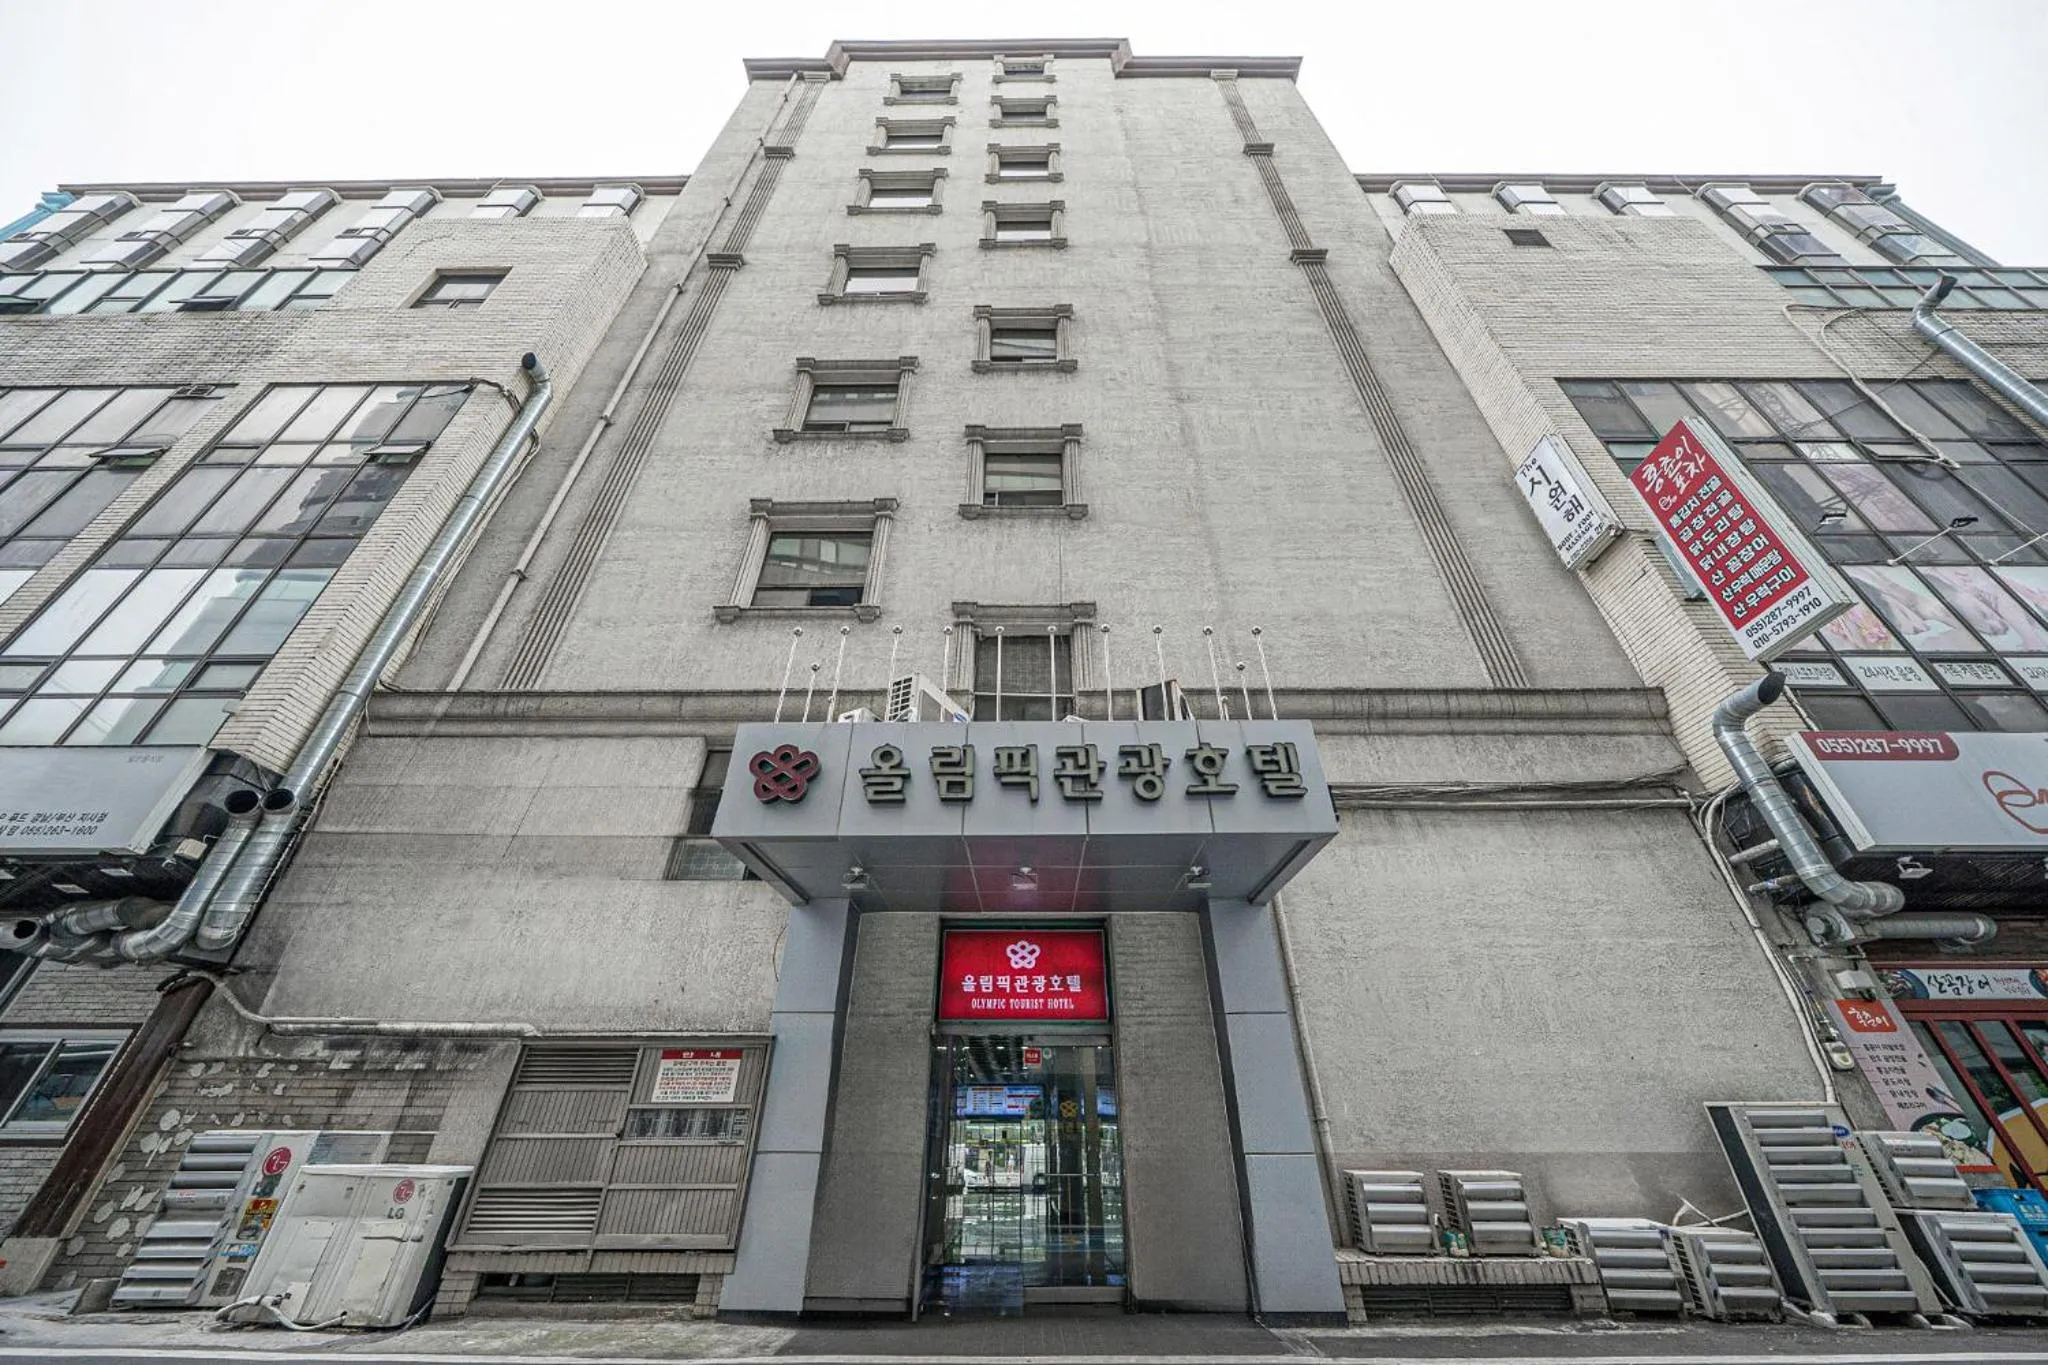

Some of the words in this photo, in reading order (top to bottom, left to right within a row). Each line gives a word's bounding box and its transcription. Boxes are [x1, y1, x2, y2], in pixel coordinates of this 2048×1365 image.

[1520, 458, 1537, 478] The
[1672, 452, 1707, 495] 포차
[1746, 586, 1812, 638] 055)287-9997
[1753, 597, 1822, 649] 010-5793-1910
[1816, 738, 1944, 754] 055)287-9997
[859, 742, 1309, 803] 올림픽관광호텔
[961, 973, 1082, 993] 올림픽관광호텔
[971, 998, 1007, 1010] OLYMPIC
[1010, 998, 1044, 1010] TOURIST
[1047, 998, 1075, 1010] HOTEL
[386, 1207, 405, 1220] LG
